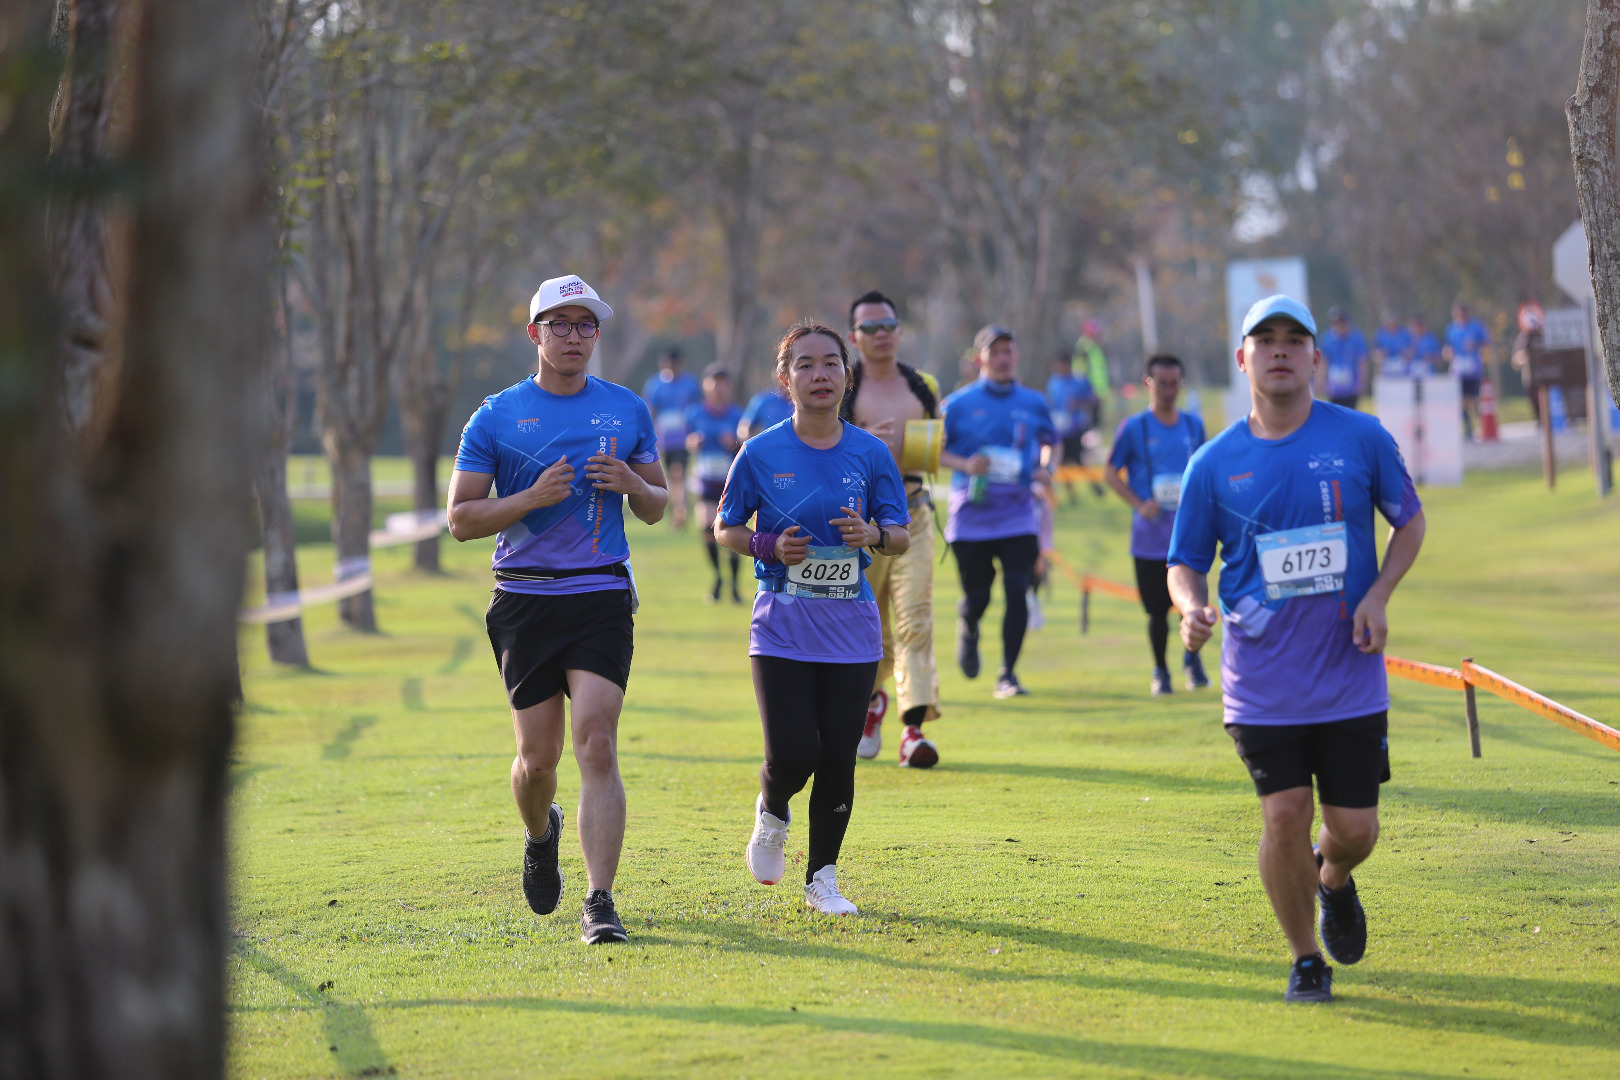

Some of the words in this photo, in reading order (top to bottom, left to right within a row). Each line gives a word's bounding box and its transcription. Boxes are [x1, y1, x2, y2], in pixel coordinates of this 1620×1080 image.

[1319, 480, 1331, 513] CROSS
[593, 499, 603, 535] CHIANG
[591, 538, 600, 553] RAI
[801, 563, 851, 580] 6028
[1282, 546, 1331, 574] 6173
